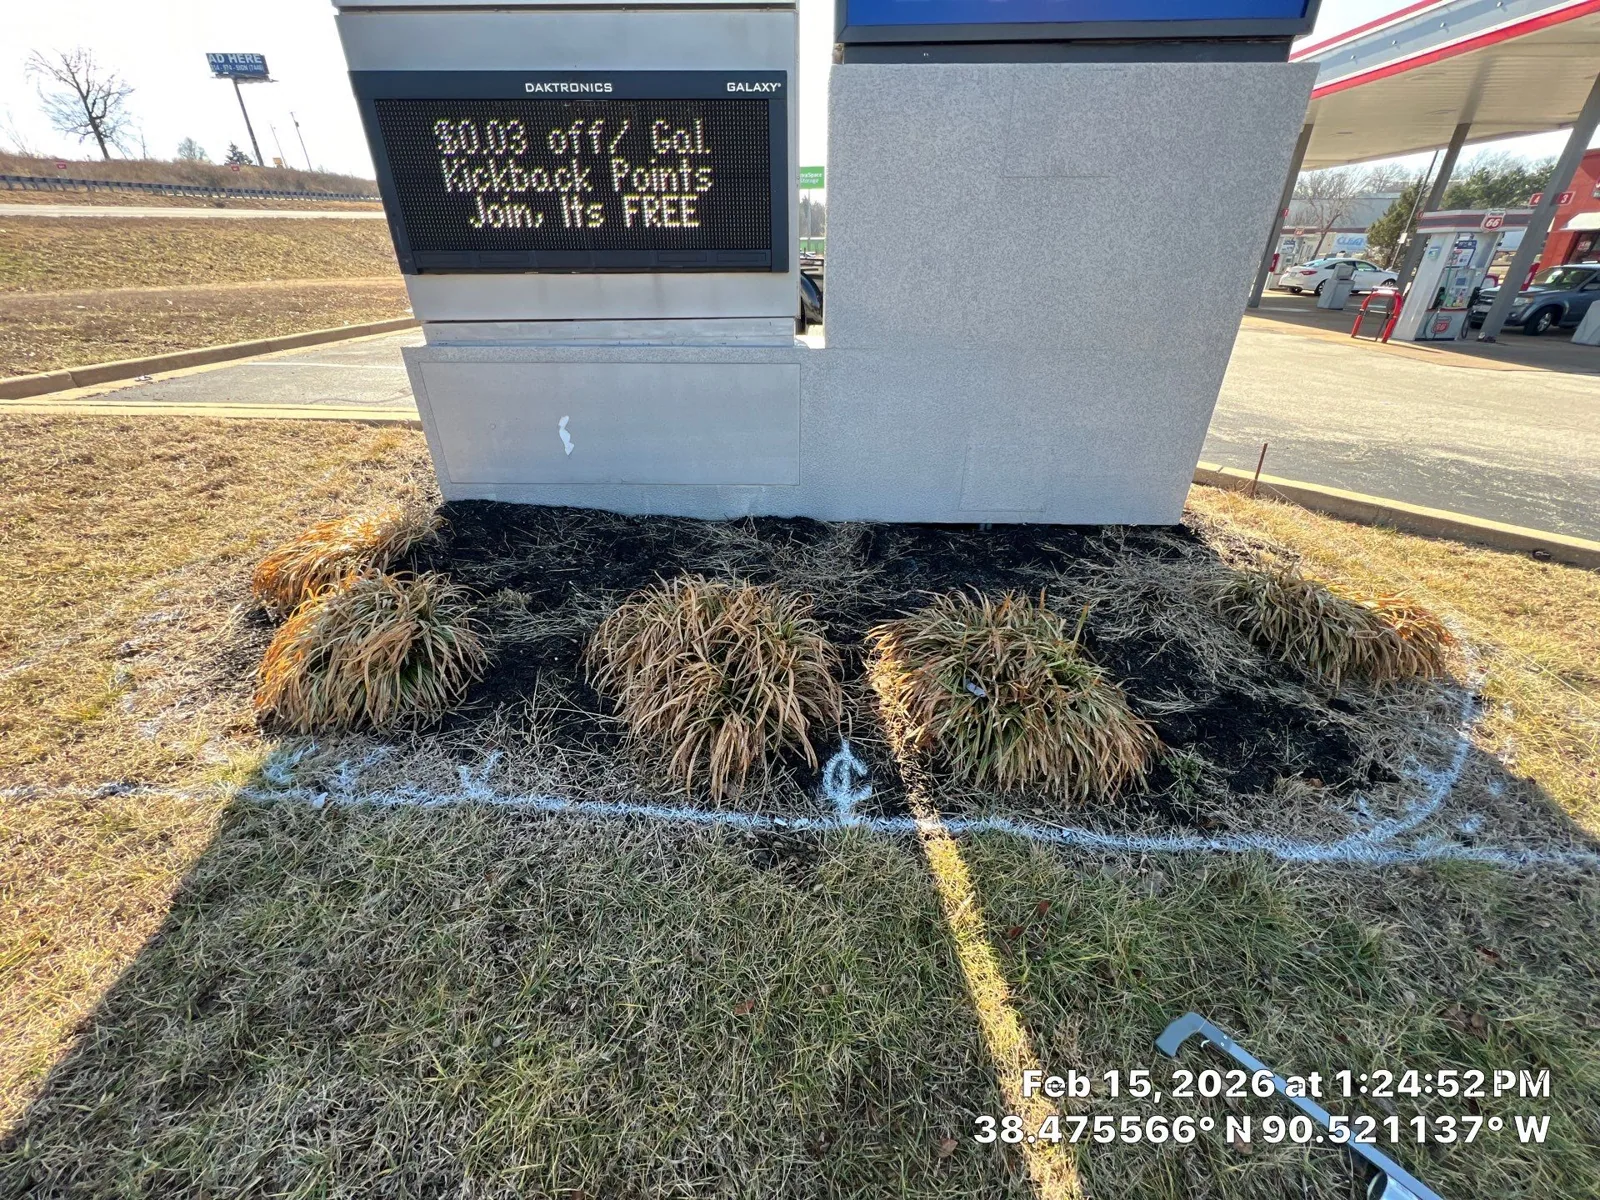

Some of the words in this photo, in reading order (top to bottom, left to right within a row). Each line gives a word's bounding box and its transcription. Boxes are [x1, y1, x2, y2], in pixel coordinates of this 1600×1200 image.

[208, 54, 225, 63] AD
[228, 54, 262, 63] HERE
[525, 82, 613, 93] DAKTRONICS
[434, 119, 527, 154] $0.03
[441, 158, 593, 192] Kickback
[611, 158, 713, 192] Points
[1560, 194, 1569, 204] 3
[561, 195, 605, 229] Its
[623, 195, 700, 228] FREE
[1485, 218, 1502, 228] 66
